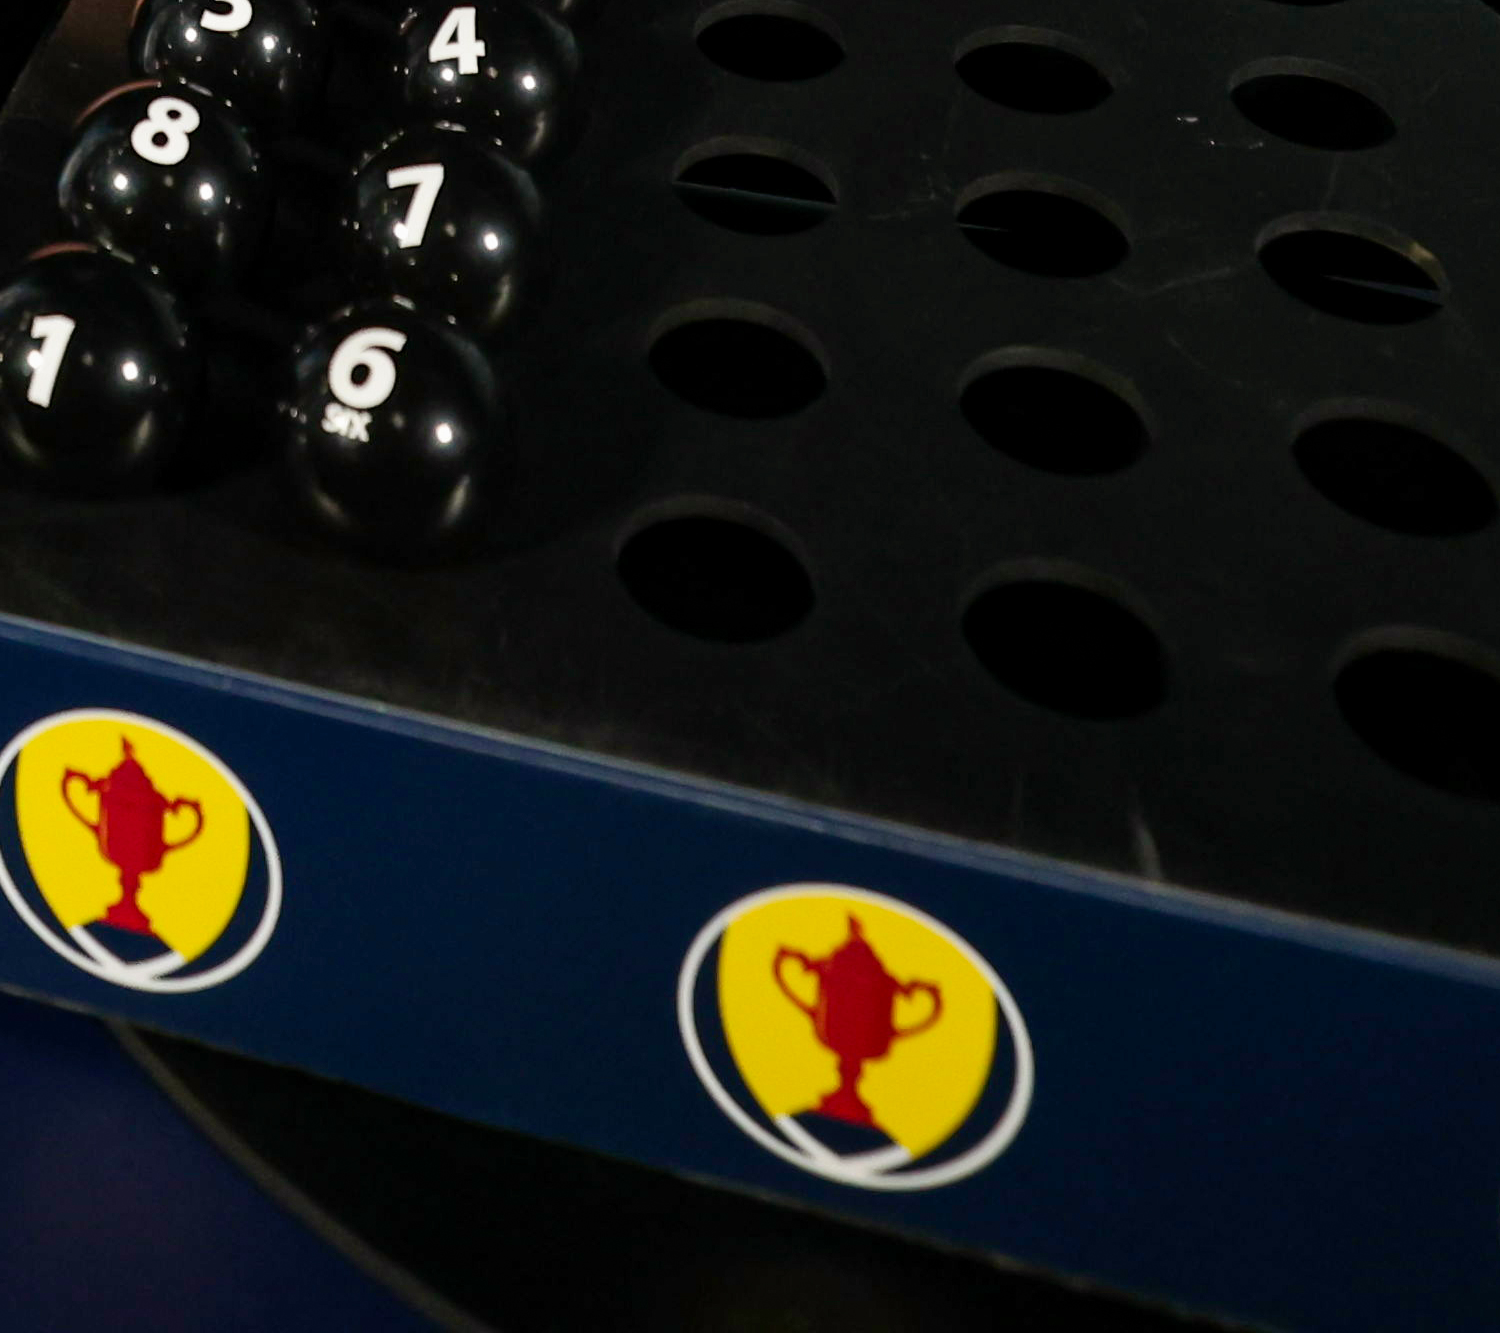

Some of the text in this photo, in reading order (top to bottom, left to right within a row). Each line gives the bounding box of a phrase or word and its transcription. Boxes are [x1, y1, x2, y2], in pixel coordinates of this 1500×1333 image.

[428, 7, 486, 76] 4
[130, 95, 200, 166] 8
[385, 164, 446, 249] 7
[28, 313, 76, 408] 1
[327, 325, 408, 409] 6
[321, 405, 371, 443] SIX
